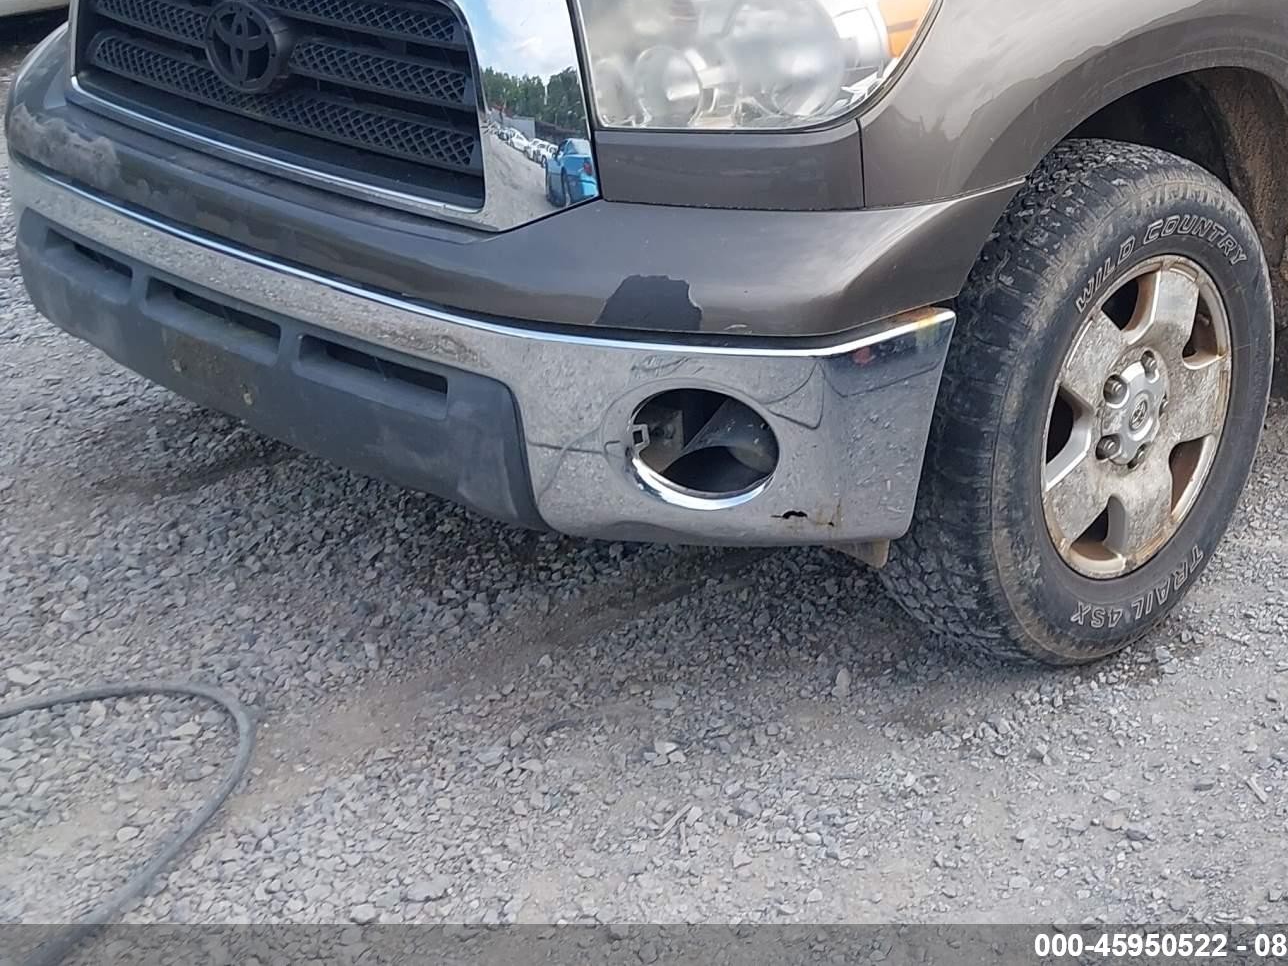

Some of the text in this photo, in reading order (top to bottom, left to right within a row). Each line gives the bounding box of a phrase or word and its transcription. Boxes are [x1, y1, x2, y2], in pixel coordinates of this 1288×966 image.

[1075, 214, 1248, 314] WILD COUNTRY
[1070, 545, 1204, 629] TRAIL 4SX
